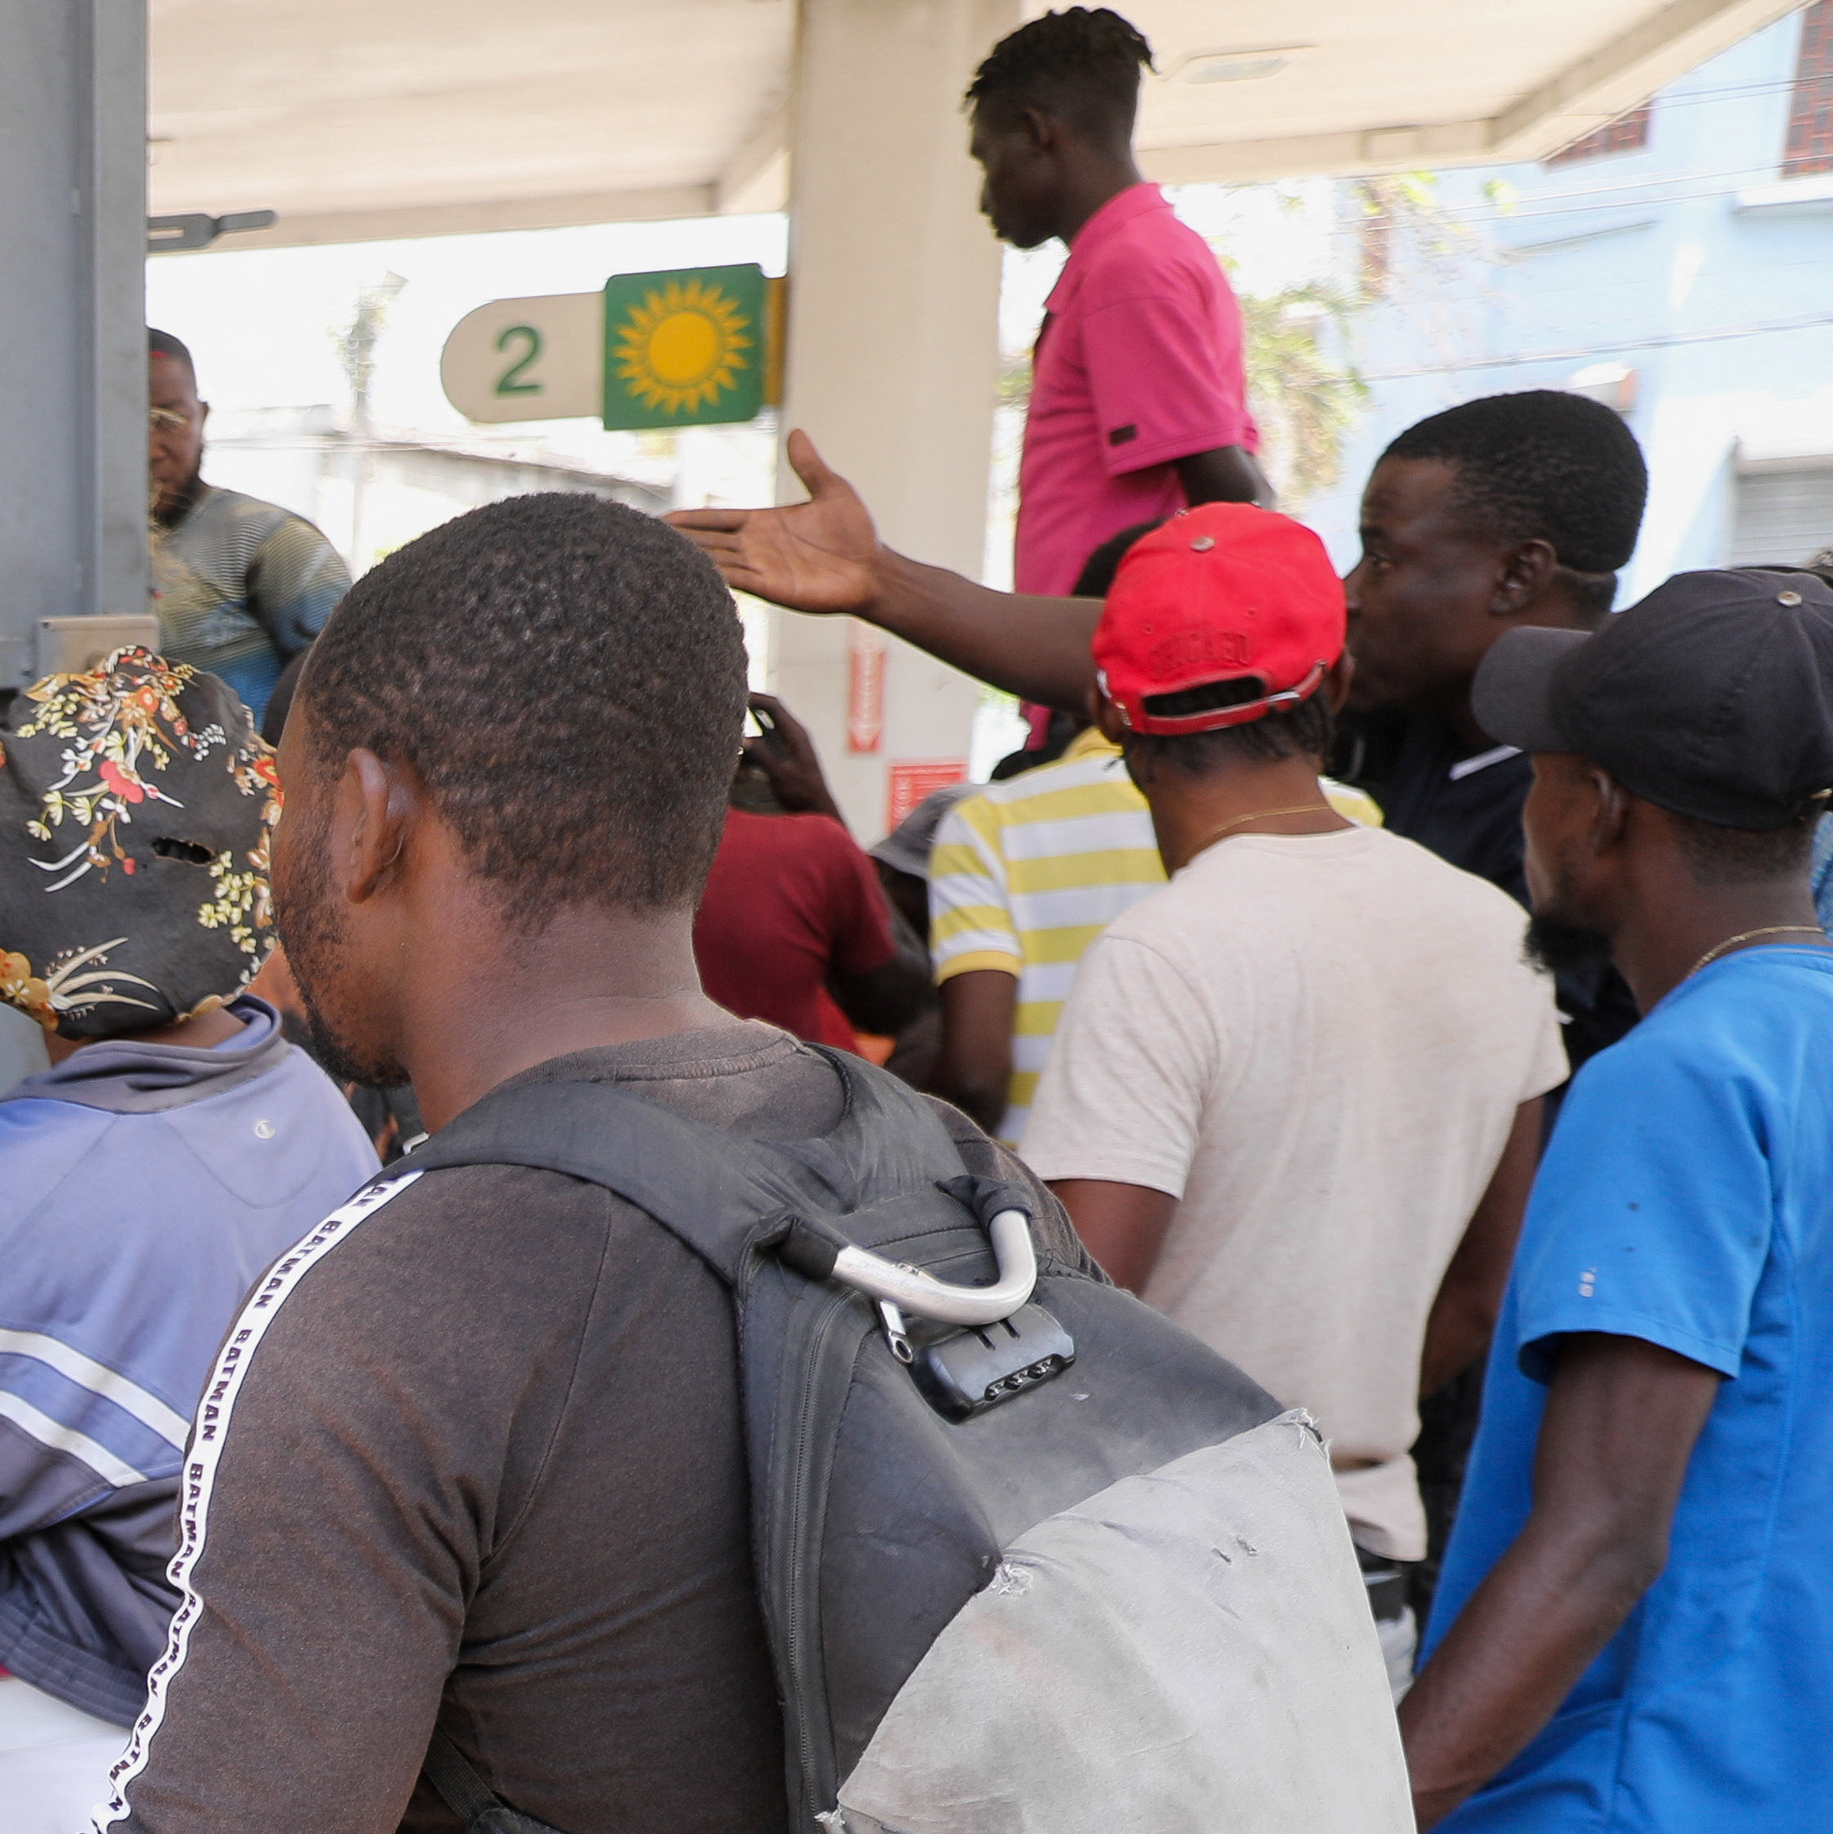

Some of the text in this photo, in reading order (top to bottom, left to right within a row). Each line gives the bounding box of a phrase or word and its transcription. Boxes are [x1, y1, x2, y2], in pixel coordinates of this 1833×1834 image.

[495, 326, 542, 396] 2
[254, 1220, 342, 1309] BATMAN
[202, 1329, 253, 1441] BATMAN
[170, 1463, 204, 1579] BATMAN
[150, 1591, 197, 1698] BATMAN
